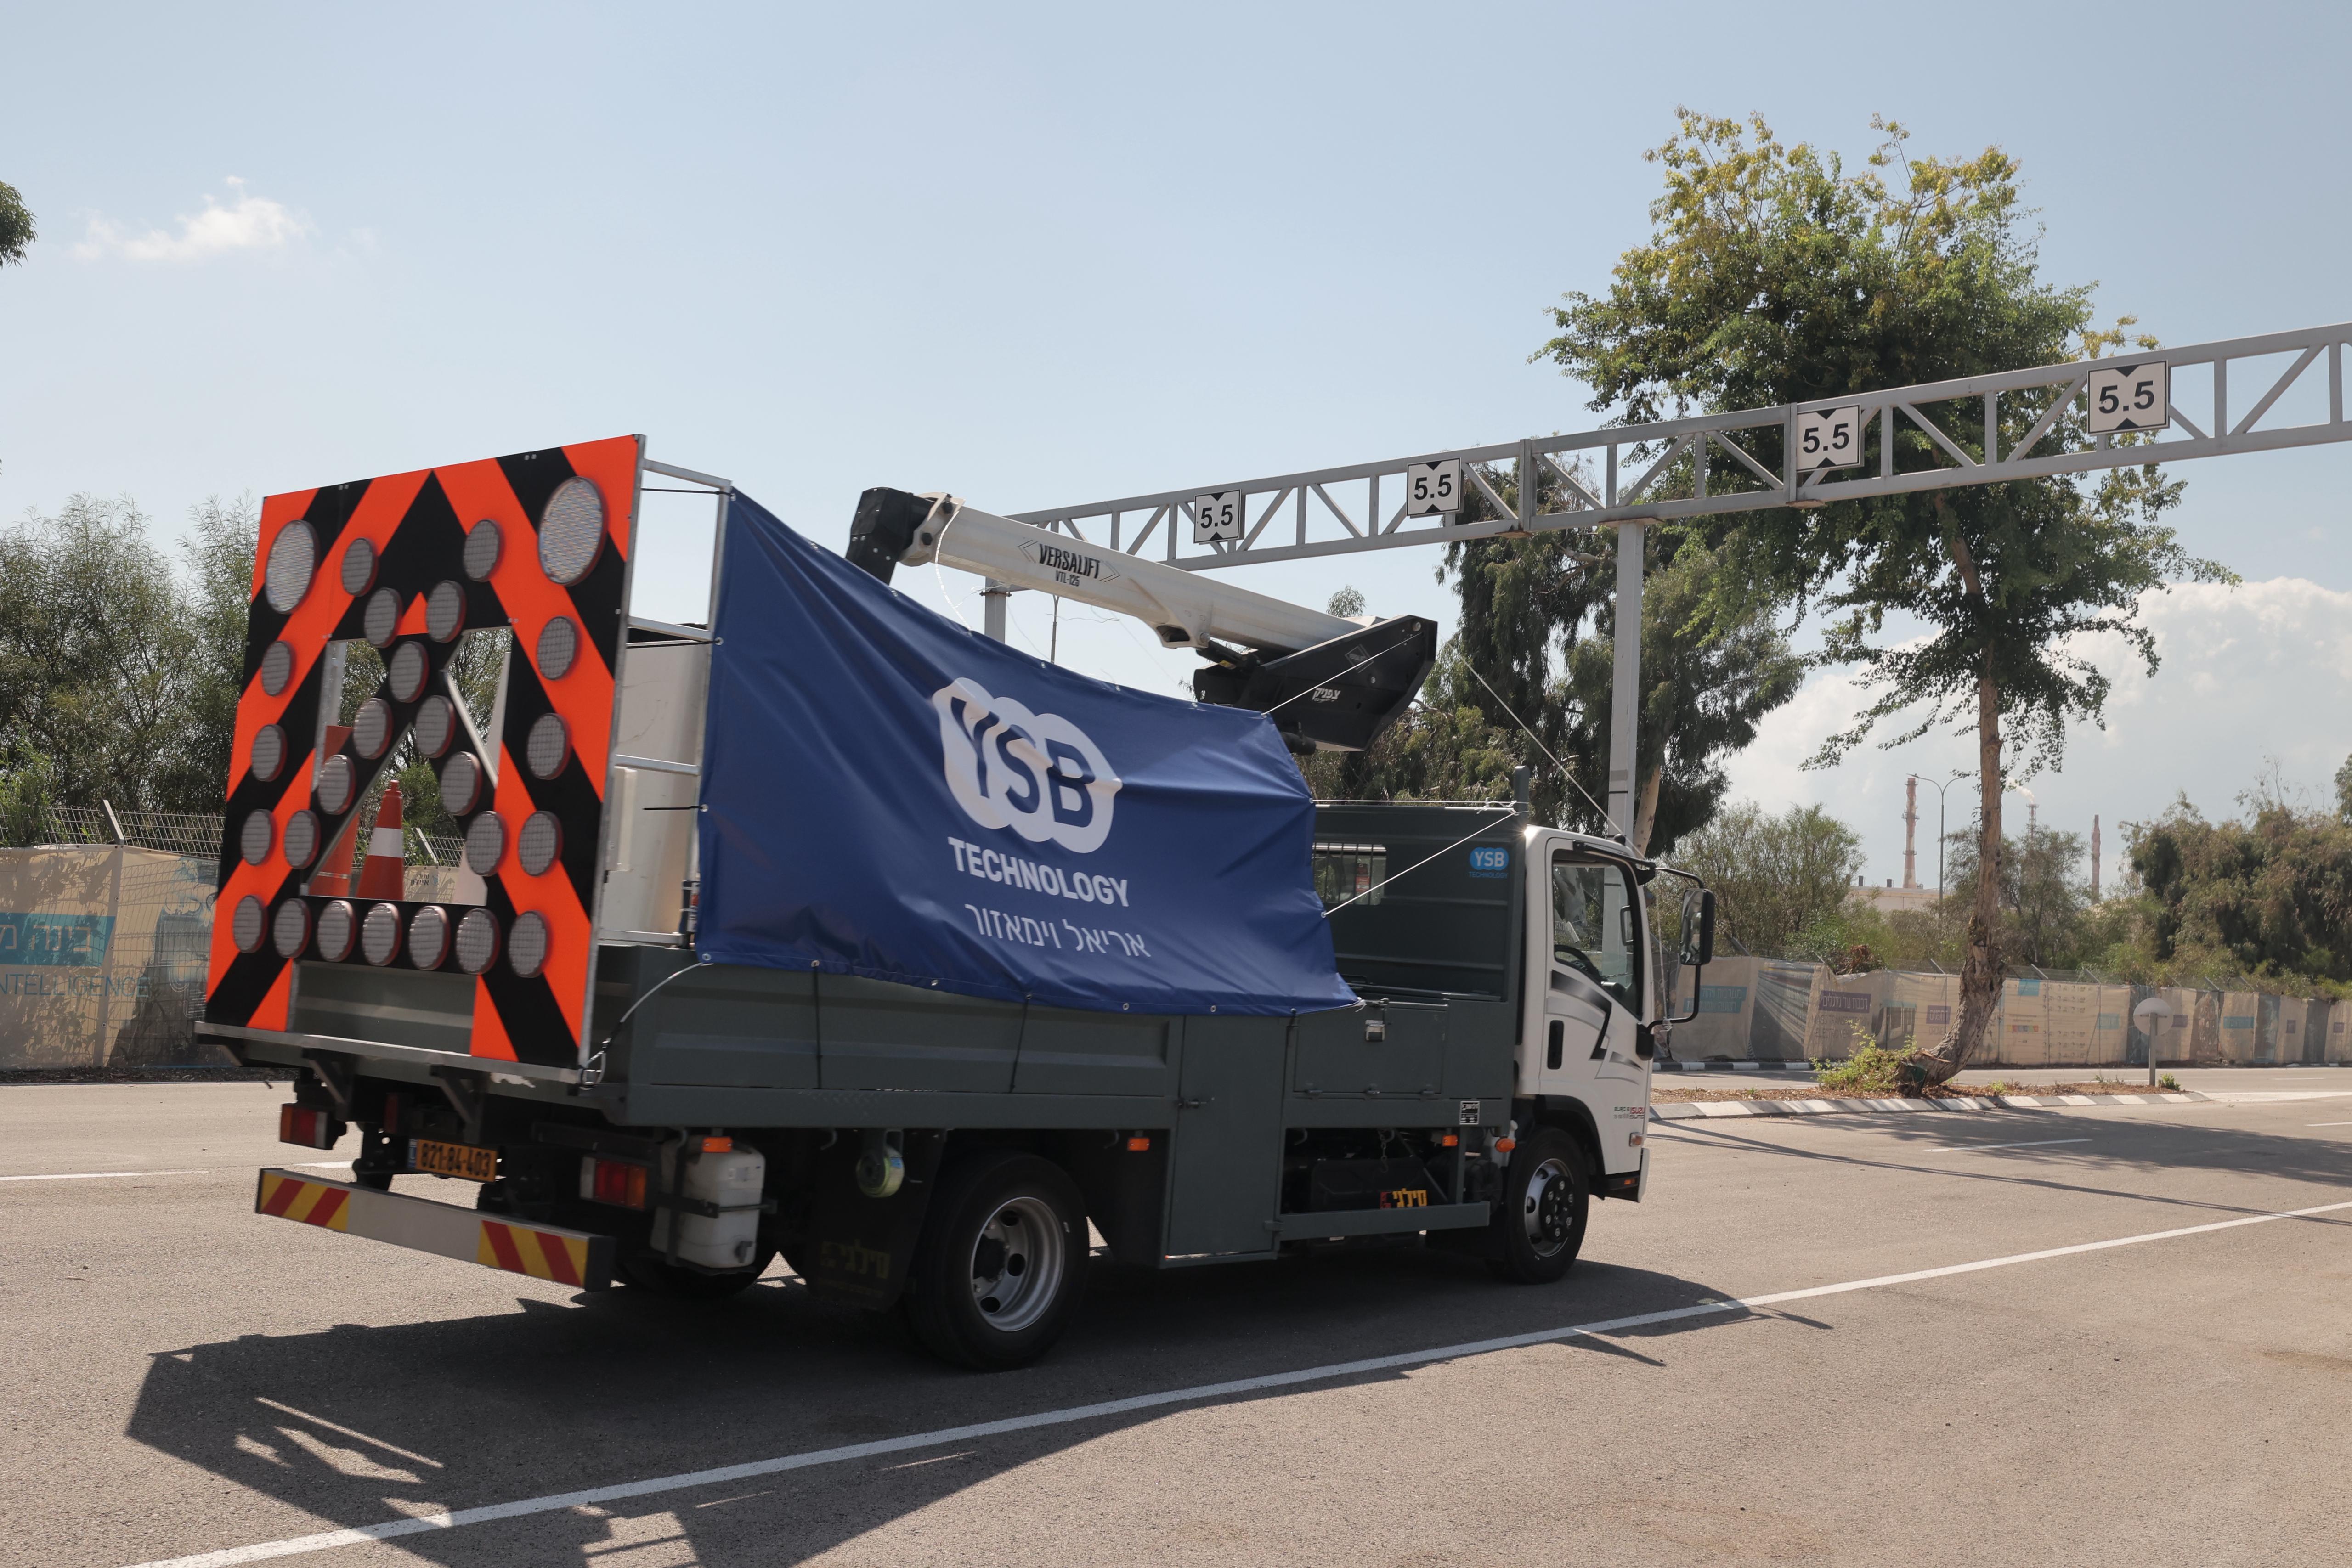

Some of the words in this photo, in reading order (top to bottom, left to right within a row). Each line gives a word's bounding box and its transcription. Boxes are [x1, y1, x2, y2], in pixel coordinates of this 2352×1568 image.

[2098, 380, 2155, 414] 5.5
[1803, 423, 1850, 454] 5.5
[1413, 474, 1452, 500] 5.5
[1200, 504, 1233, 529] 5.5
[1039, 543, 1100, 579] VERSALIFT
[950, 696, 1096, 828] YSB
[947, 836, 1129, 907] TECHNOLOGY
[1474, 851, 1505, 867] YSB
[1062, 919, 1152, 958] אריאל
[421, 1143, 490, 1177] 821-84-403
